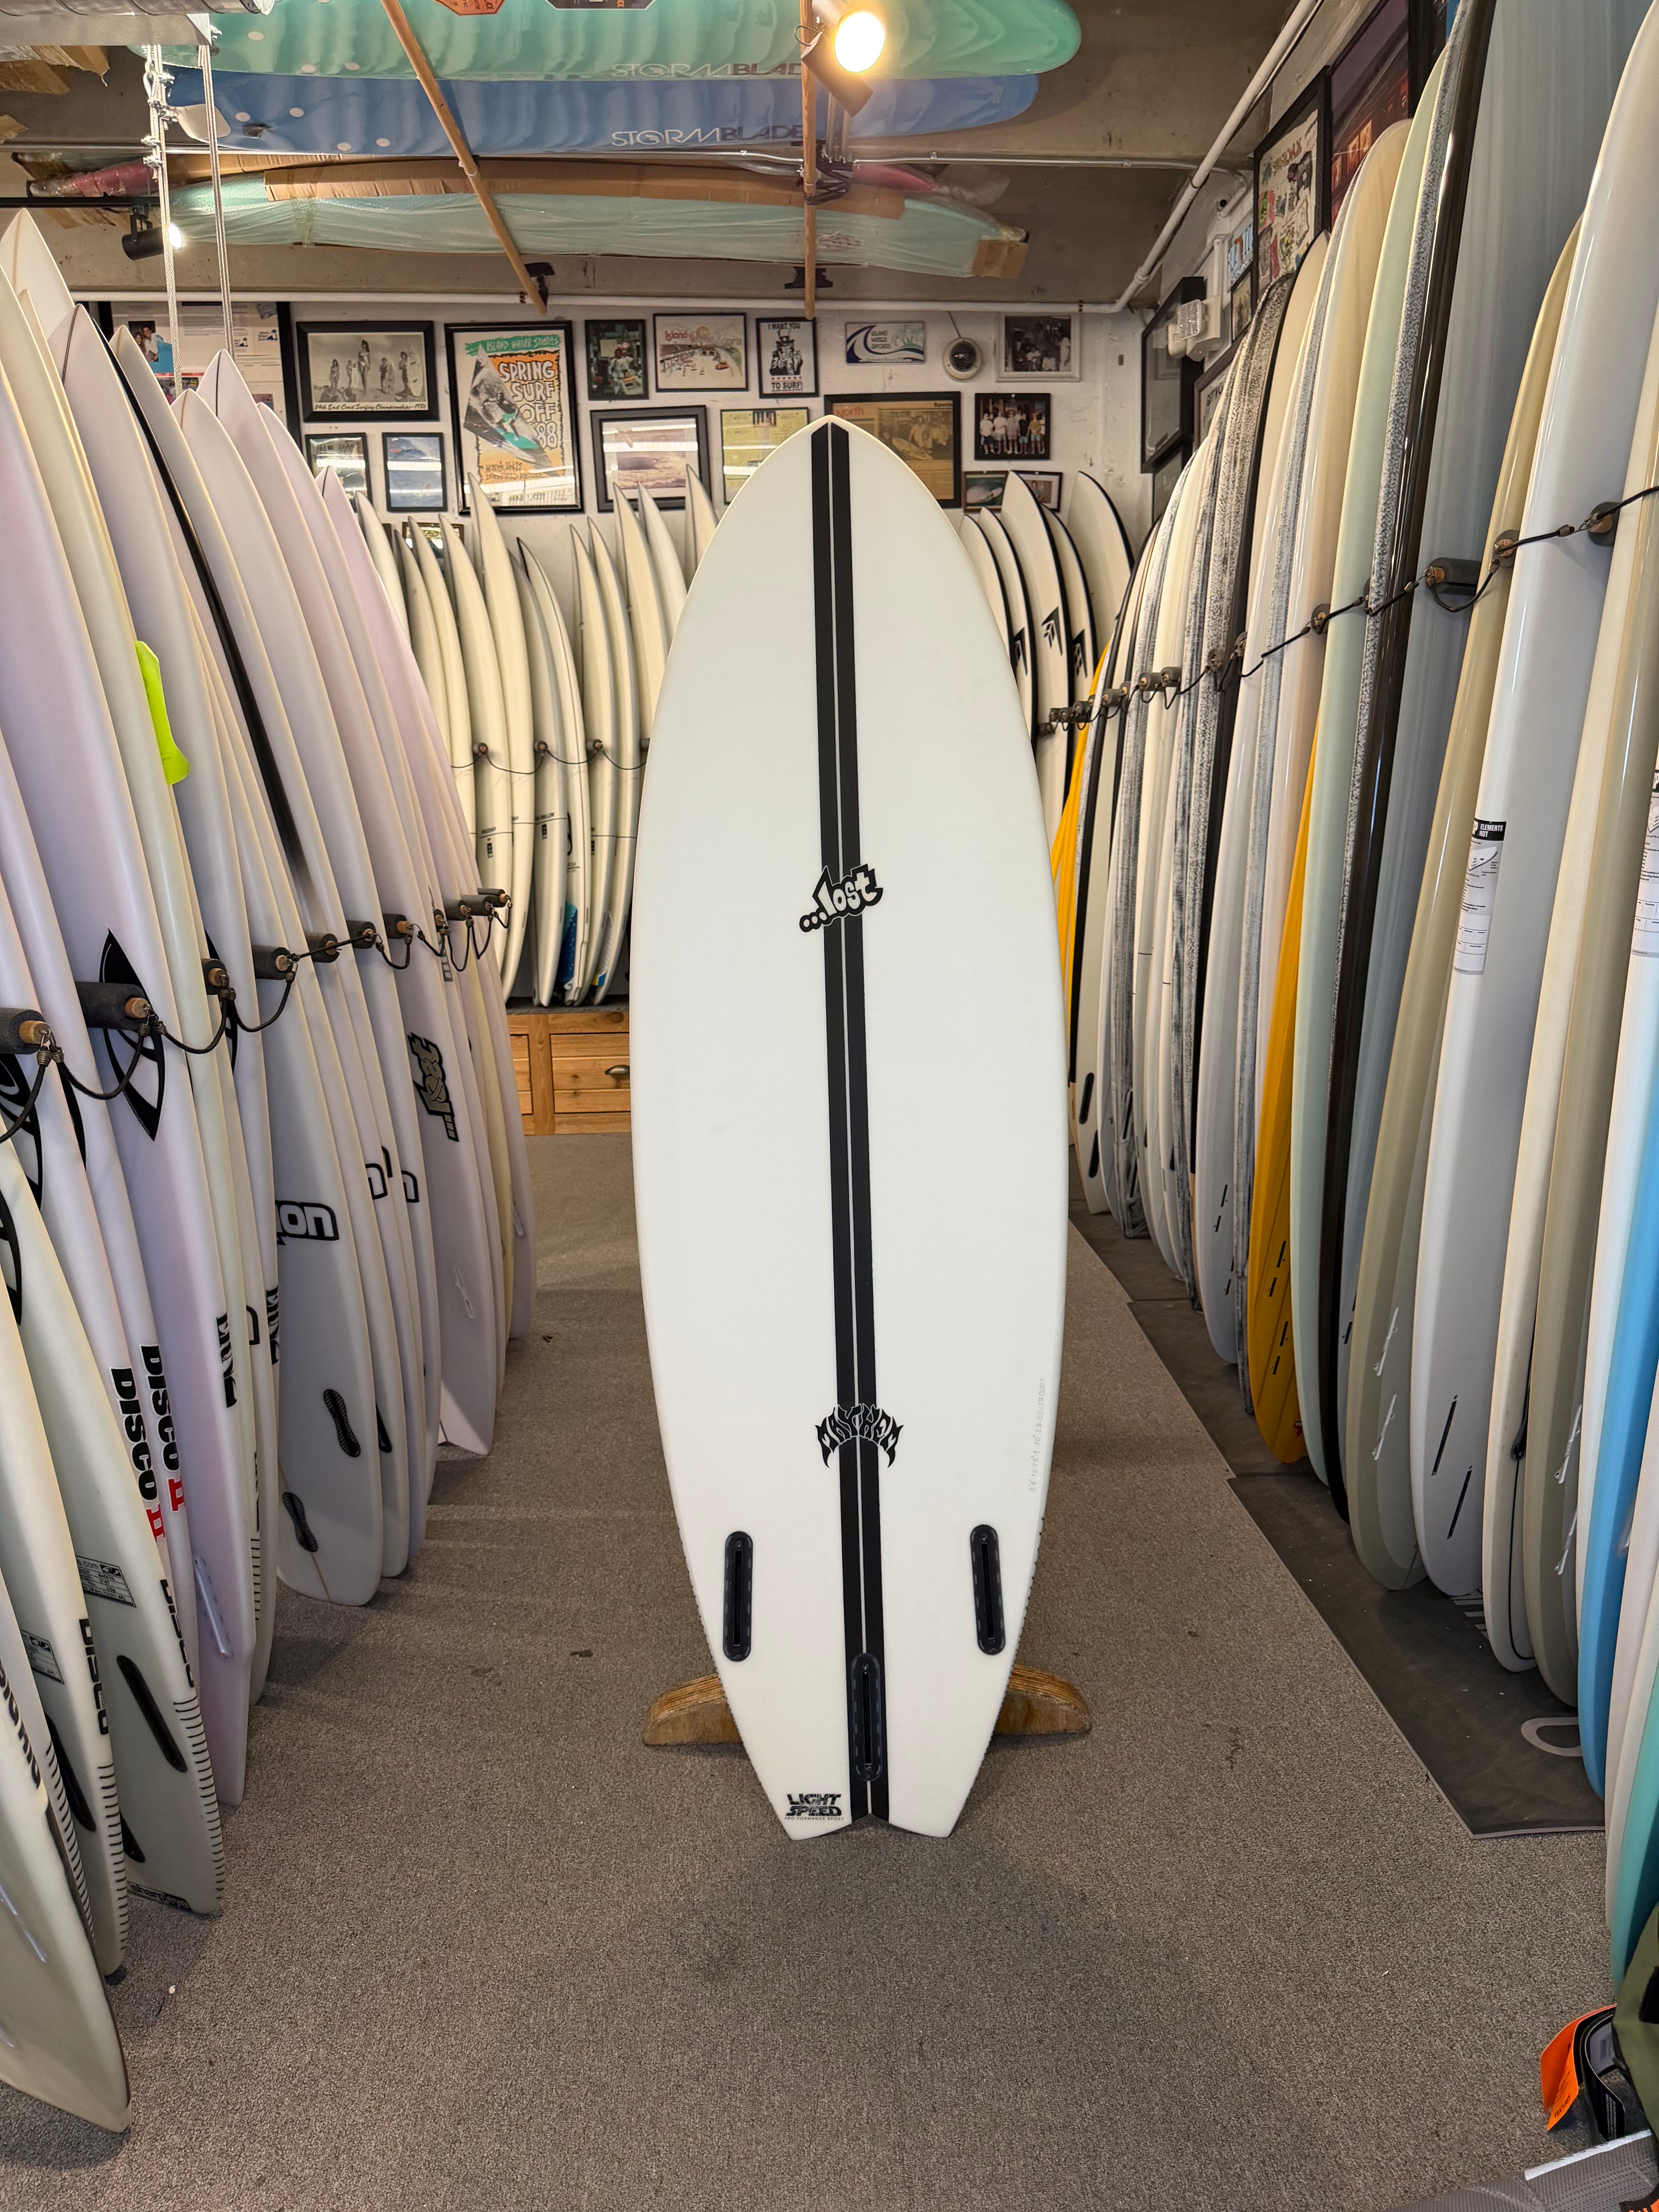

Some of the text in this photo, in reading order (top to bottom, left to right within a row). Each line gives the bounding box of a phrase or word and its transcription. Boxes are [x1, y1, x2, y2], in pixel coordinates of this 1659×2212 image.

[611, 63, 802, 77] STORMBLAD
[486, 340, 509, 351] ISLAND
[512, 338, 532, 349] WATER
[498, 361, 557, 383] SPRING
[510, 381, 556, 402] SURF
[518, 402, 556, 424] OFF
[141, 1345, 180, 1471] DISCO
[110, 1367, 158, 1501] DISCO
[787, 1794, 842, 1805] LIGHT
[786, 1806, 842, 1816] SPEED
